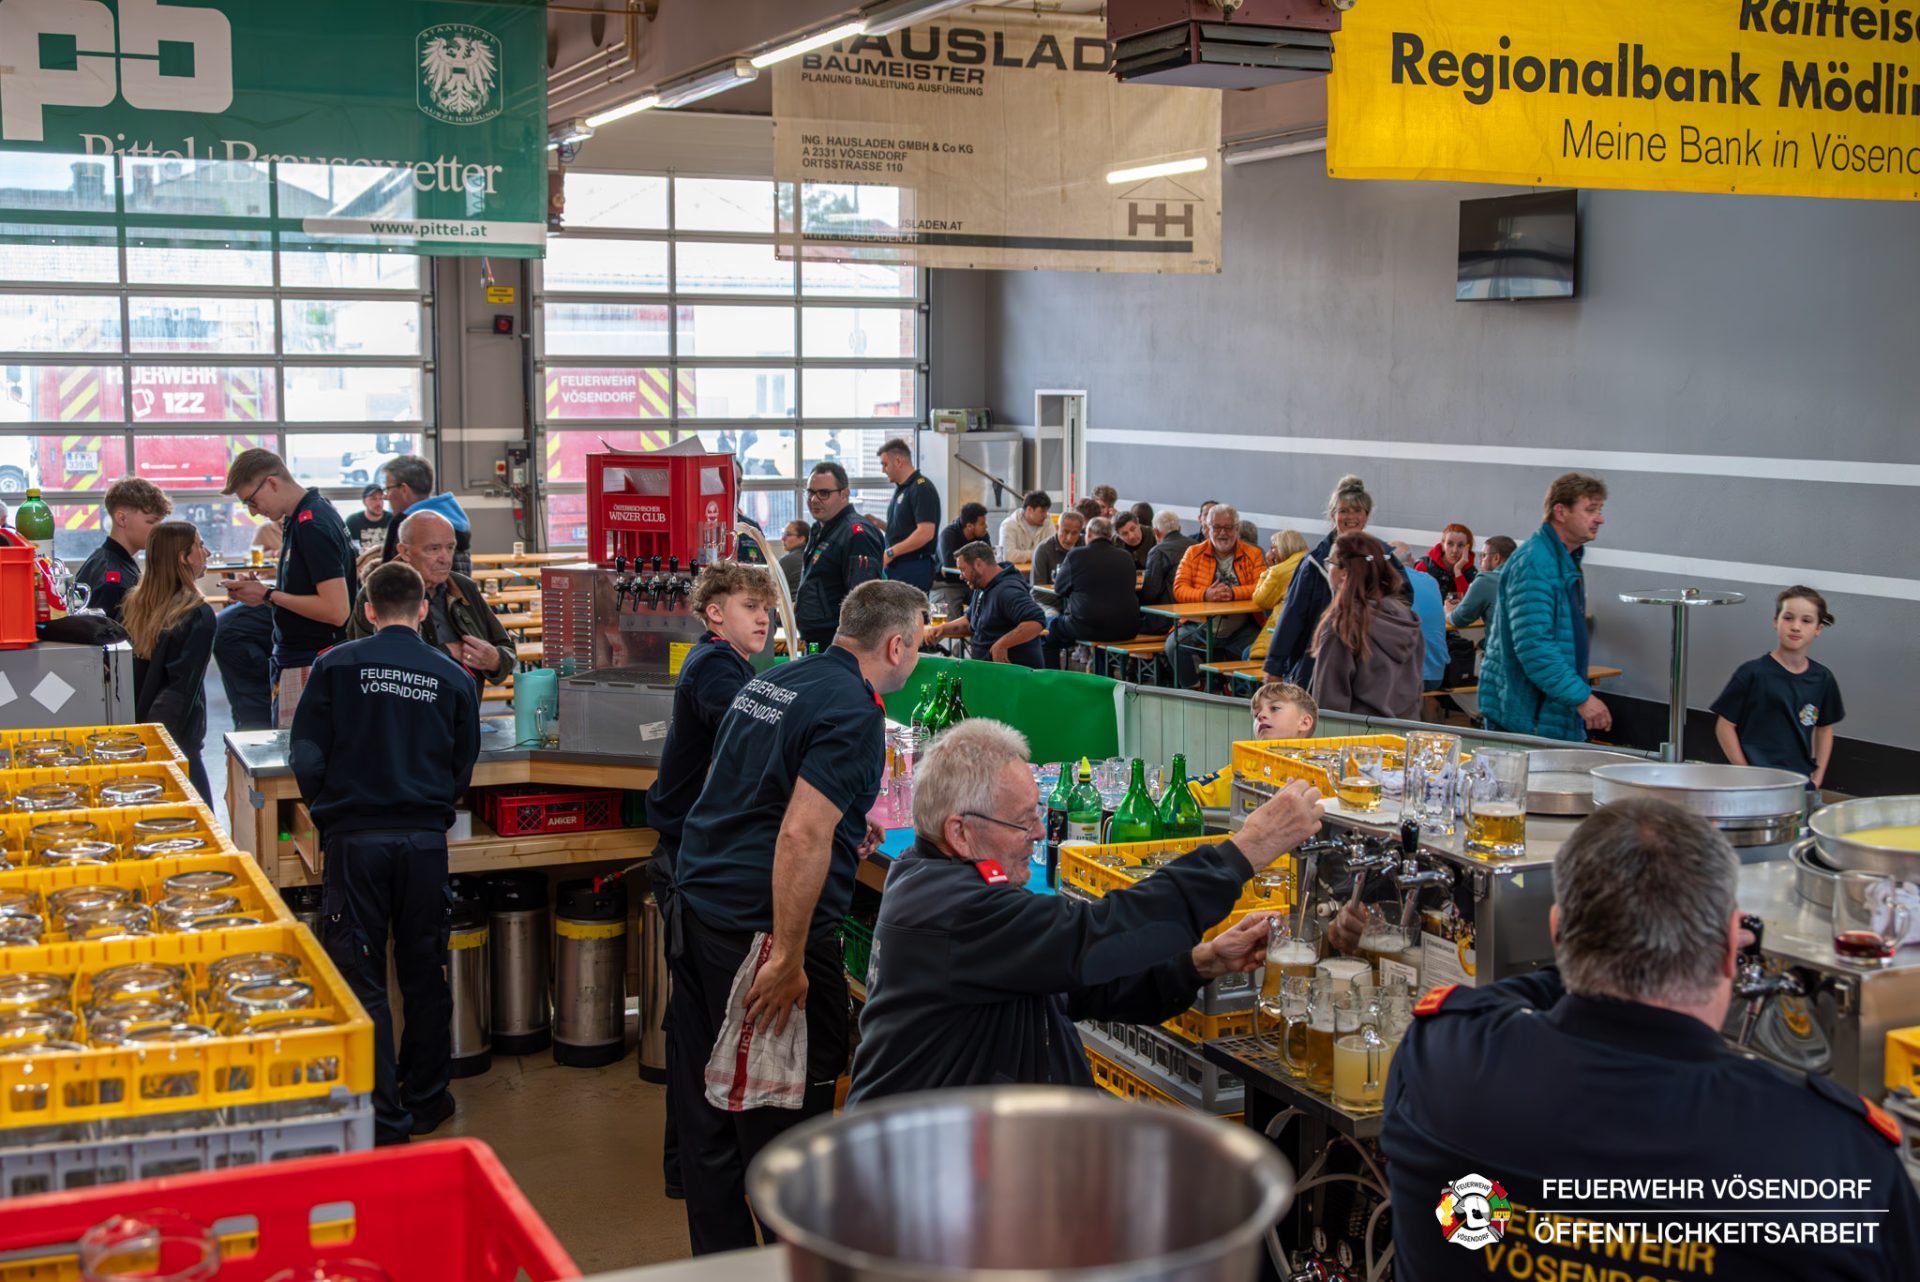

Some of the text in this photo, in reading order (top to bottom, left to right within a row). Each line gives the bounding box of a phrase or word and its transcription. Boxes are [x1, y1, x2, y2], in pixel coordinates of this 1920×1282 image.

[1740, 0, 1920, 43] Raiffeis
[833, 25, 1114, 73] AUSLAD
[802, 54, 985, 84] BAUMEISTER
[1391, 32, 1761, 105] Regionalbank
[801, 72, 983, 96] PLANUNG BAULEITUNG AUSFÜHRUNG
[802, 135, 974, 154] ING. HAUSLADEN GMBH & Co KG
[802, 147, 908, 161] A 2331 VÖSENDORF
[1562, 119, 1667, 162] Meine
[1680, 126, 1762, 168] Bank
[1772, 131, 1799, 168] in
[802, 158, 903, 172] ORTSSTRASSE 110
[370, 220, 488, 238] www.pittel.at
[560, 375, 637, 387] FEUERWEHR
[163, 392, 206, 413] 122
[562, 390, 637, 403] VÖSENDORF
[609, 511, 667, 522] WINZER CLUB
[360, 668, 439, 689] FEUERWEHR
[360, 680, 438, 703] VÖSENDORF
[744, 678, 798, 705] FEUERWEHR
[547, 816, 577, 826] ANKER
[1507, 1202, 1717, 1275] EUERWEHR
